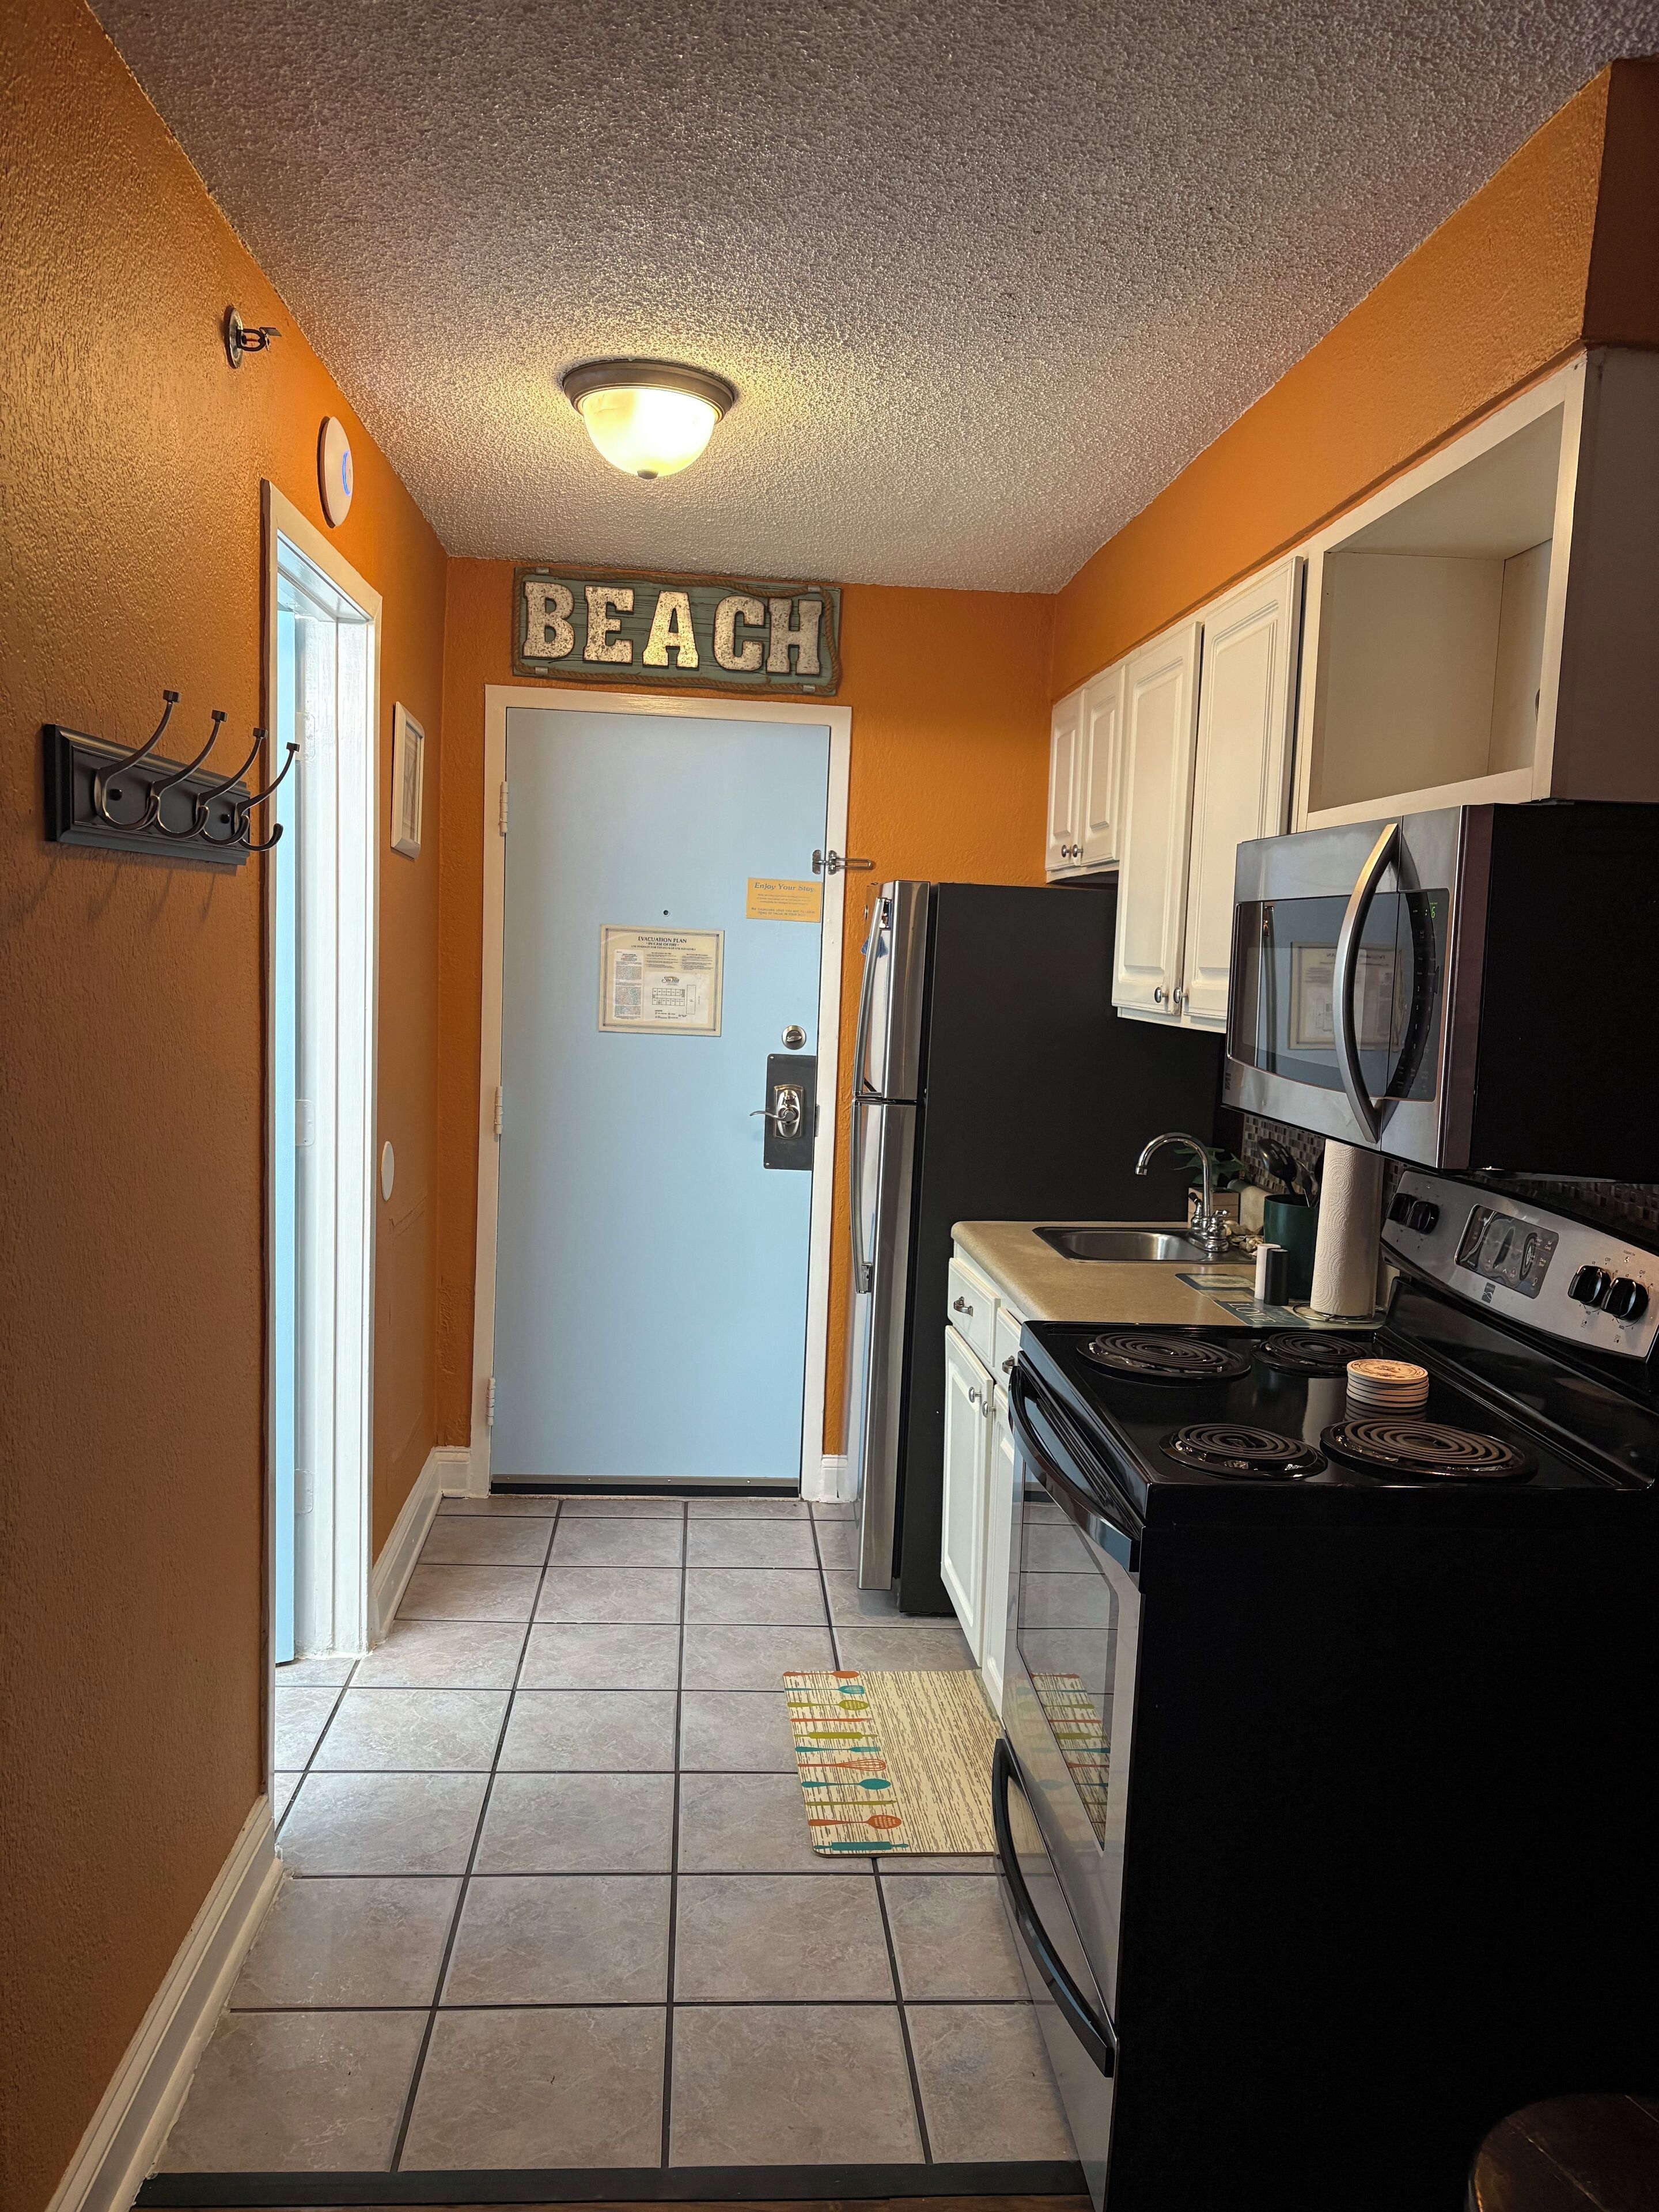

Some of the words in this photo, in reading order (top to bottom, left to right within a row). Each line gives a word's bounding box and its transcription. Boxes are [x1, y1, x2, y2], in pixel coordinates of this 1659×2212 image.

[522, 581, 823, 676] BEACH
[754, 882, 776, 891] Enjoy
[798, 885, 815, 893] Stay
[1227, 1302, 1277, 1323] LOVE
